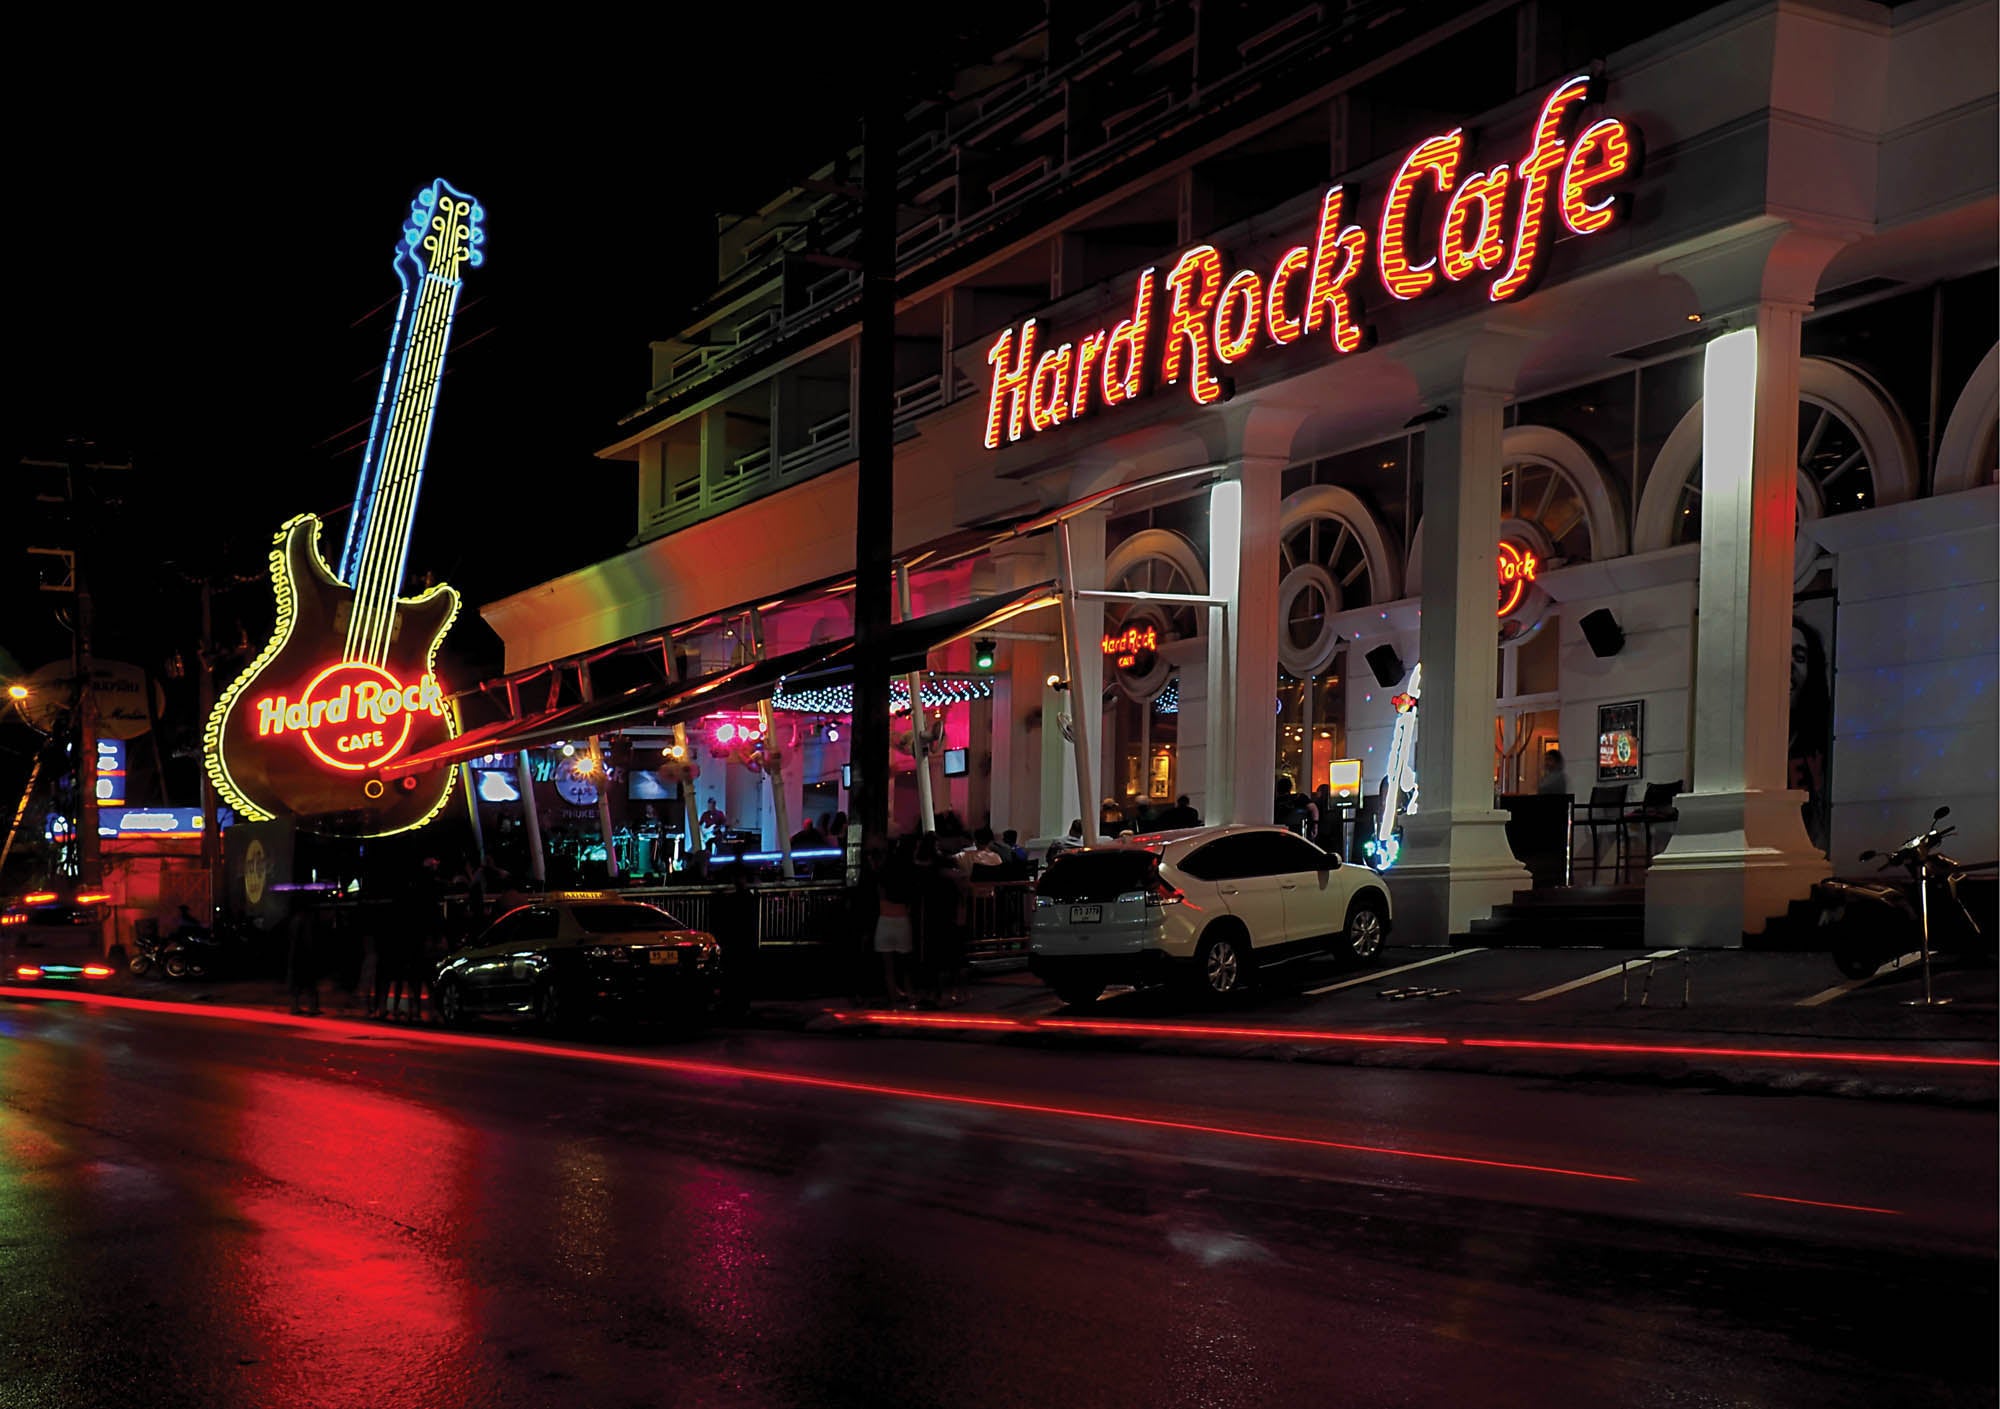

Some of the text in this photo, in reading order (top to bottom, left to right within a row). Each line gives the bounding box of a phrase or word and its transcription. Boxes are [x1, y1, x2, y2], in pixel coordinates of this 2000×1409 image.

[984, 75, 1631, 449] Hard Rock Cafe
[1127, 626, 1156, 654] Rock
[257, 673, 443, 736] Hard Rock
[336, 730, 385, 753] CAFE
